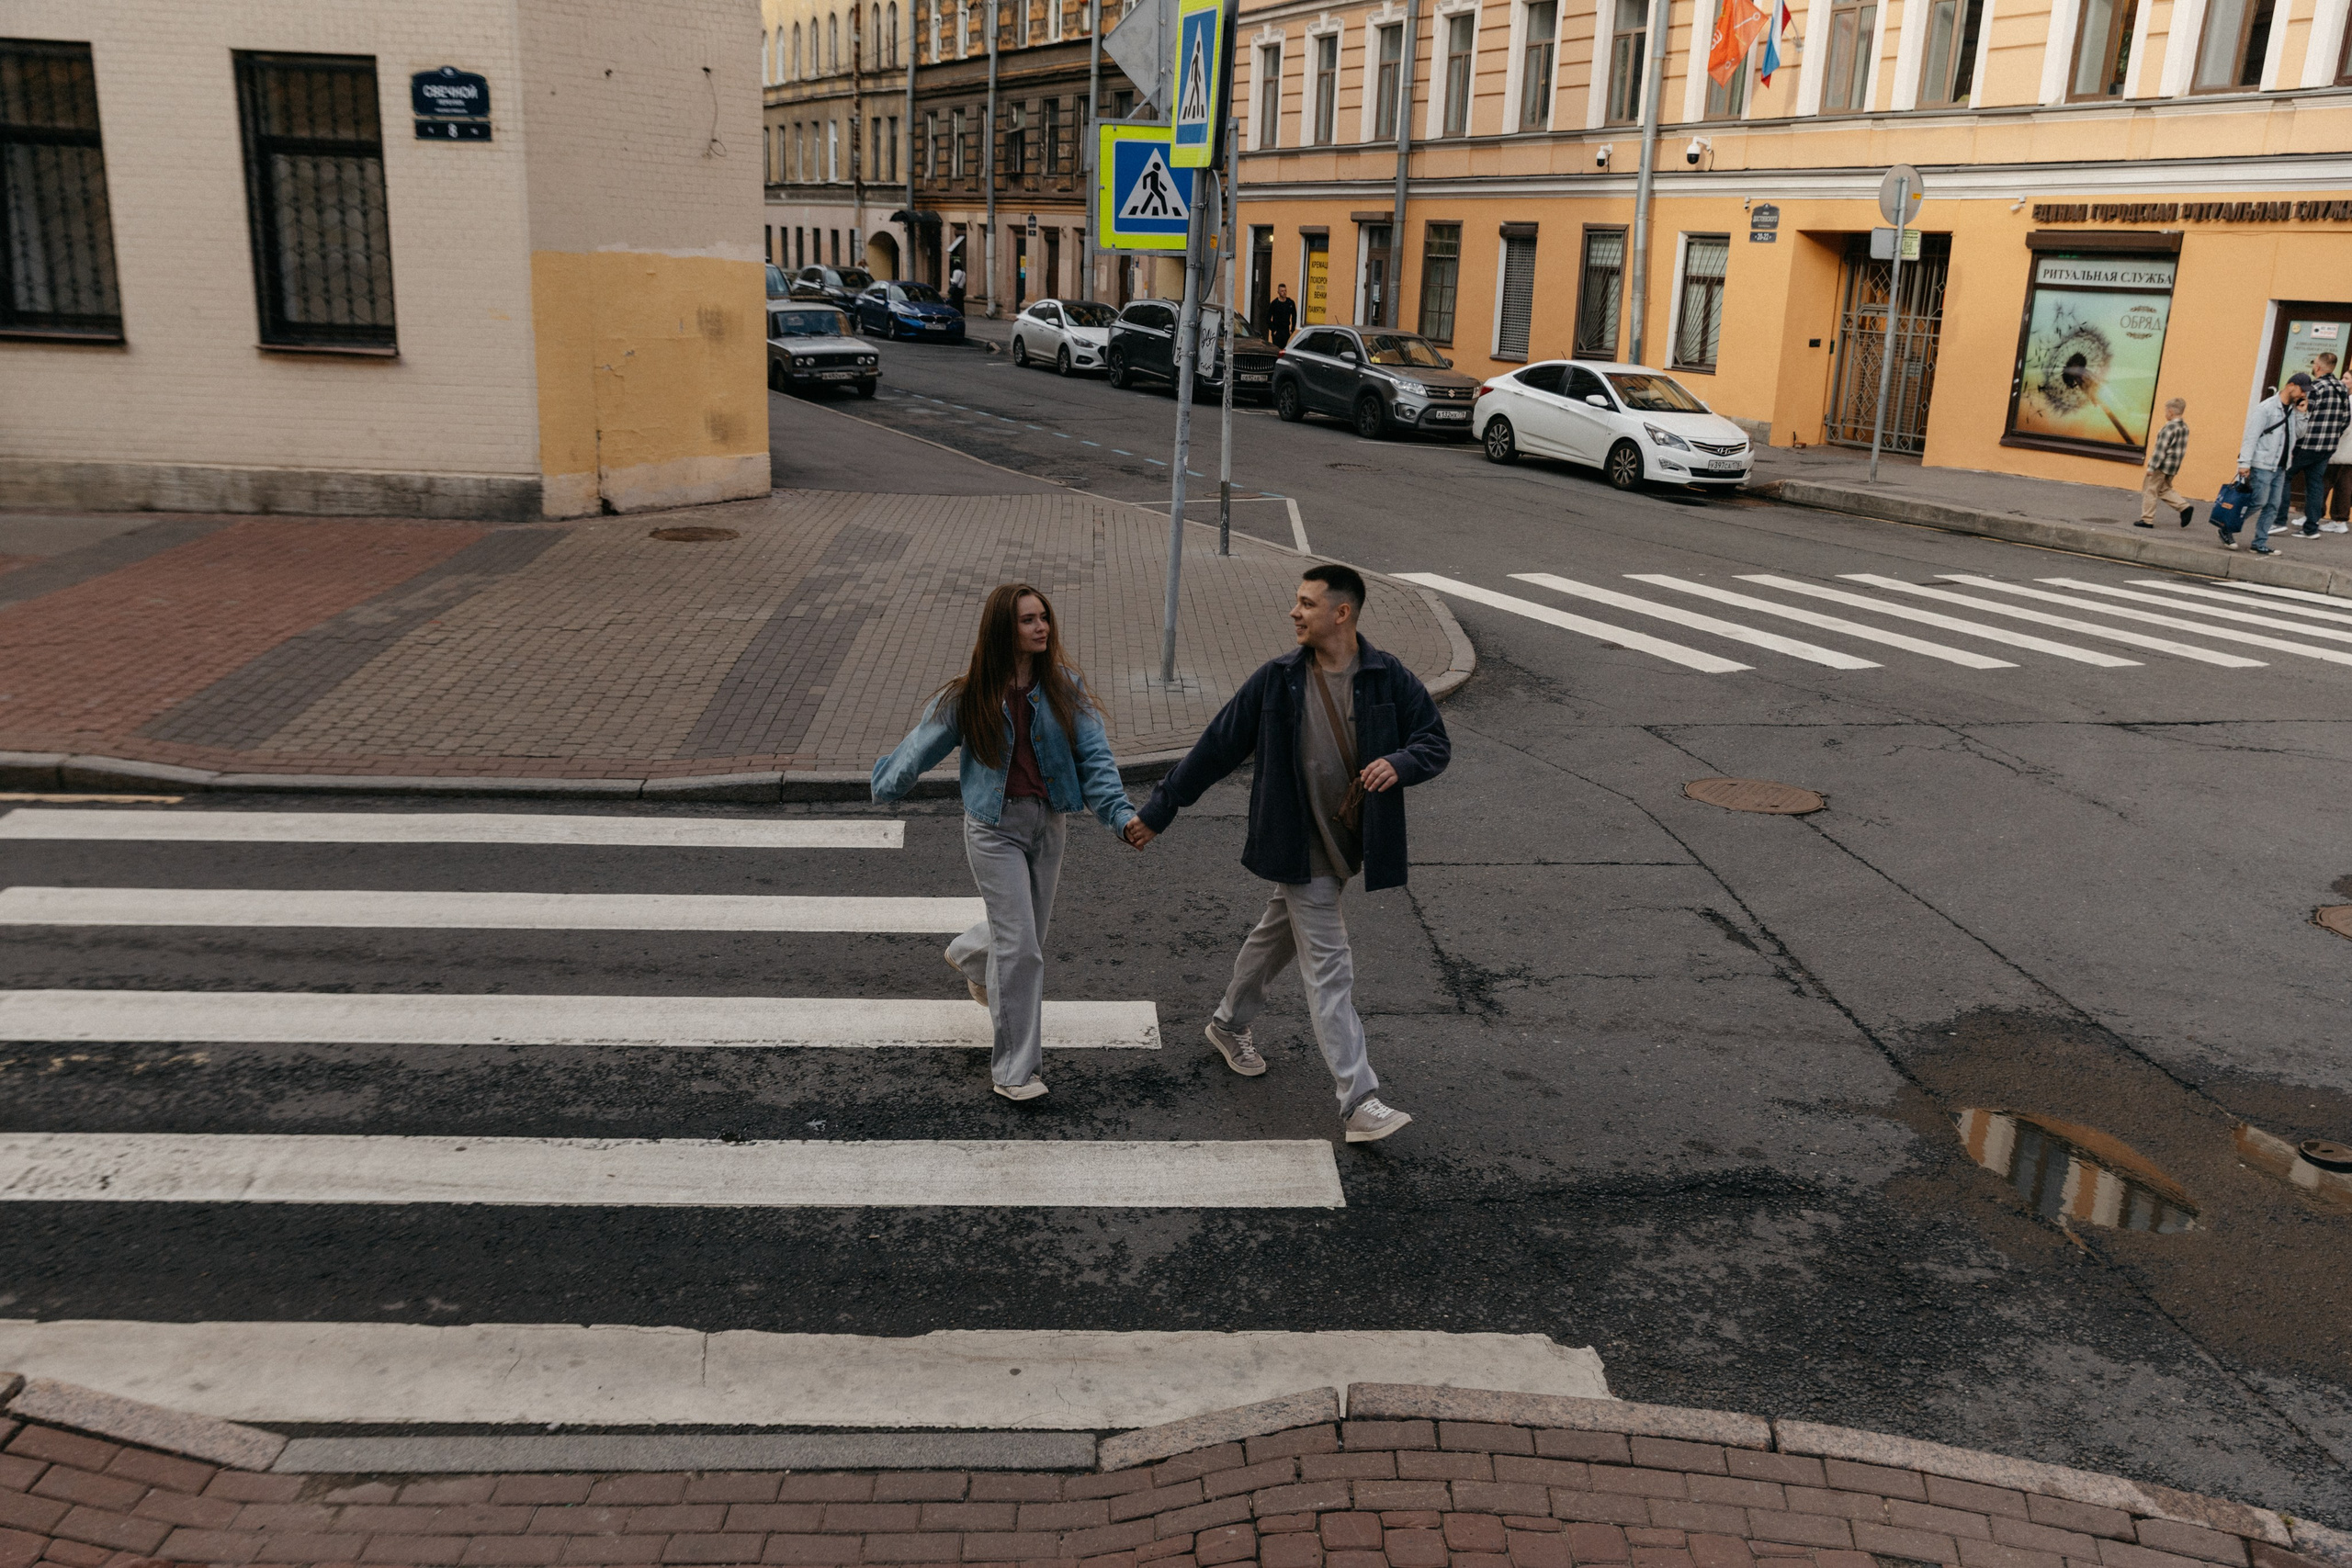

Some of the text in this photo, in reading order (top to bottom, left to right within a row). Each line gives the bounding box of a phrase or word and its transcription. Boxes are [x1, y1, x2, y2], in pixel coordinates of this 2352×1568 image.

[423, 84, 478, 99] СВЕЧНОЙ
[2032, 204, 2088, 221] ЕДИНАЯ
[2090, 203, 2178, 221] ГОРОДСКАЯ
[2183, 202, 2291, 220] РИТУАЛЬНАЯ
[2043, 268, 2173, 285] РИТУАЛЬНАЯ СЛУЖБА
[2120, 314, 2161, 331] ОБРЯД
